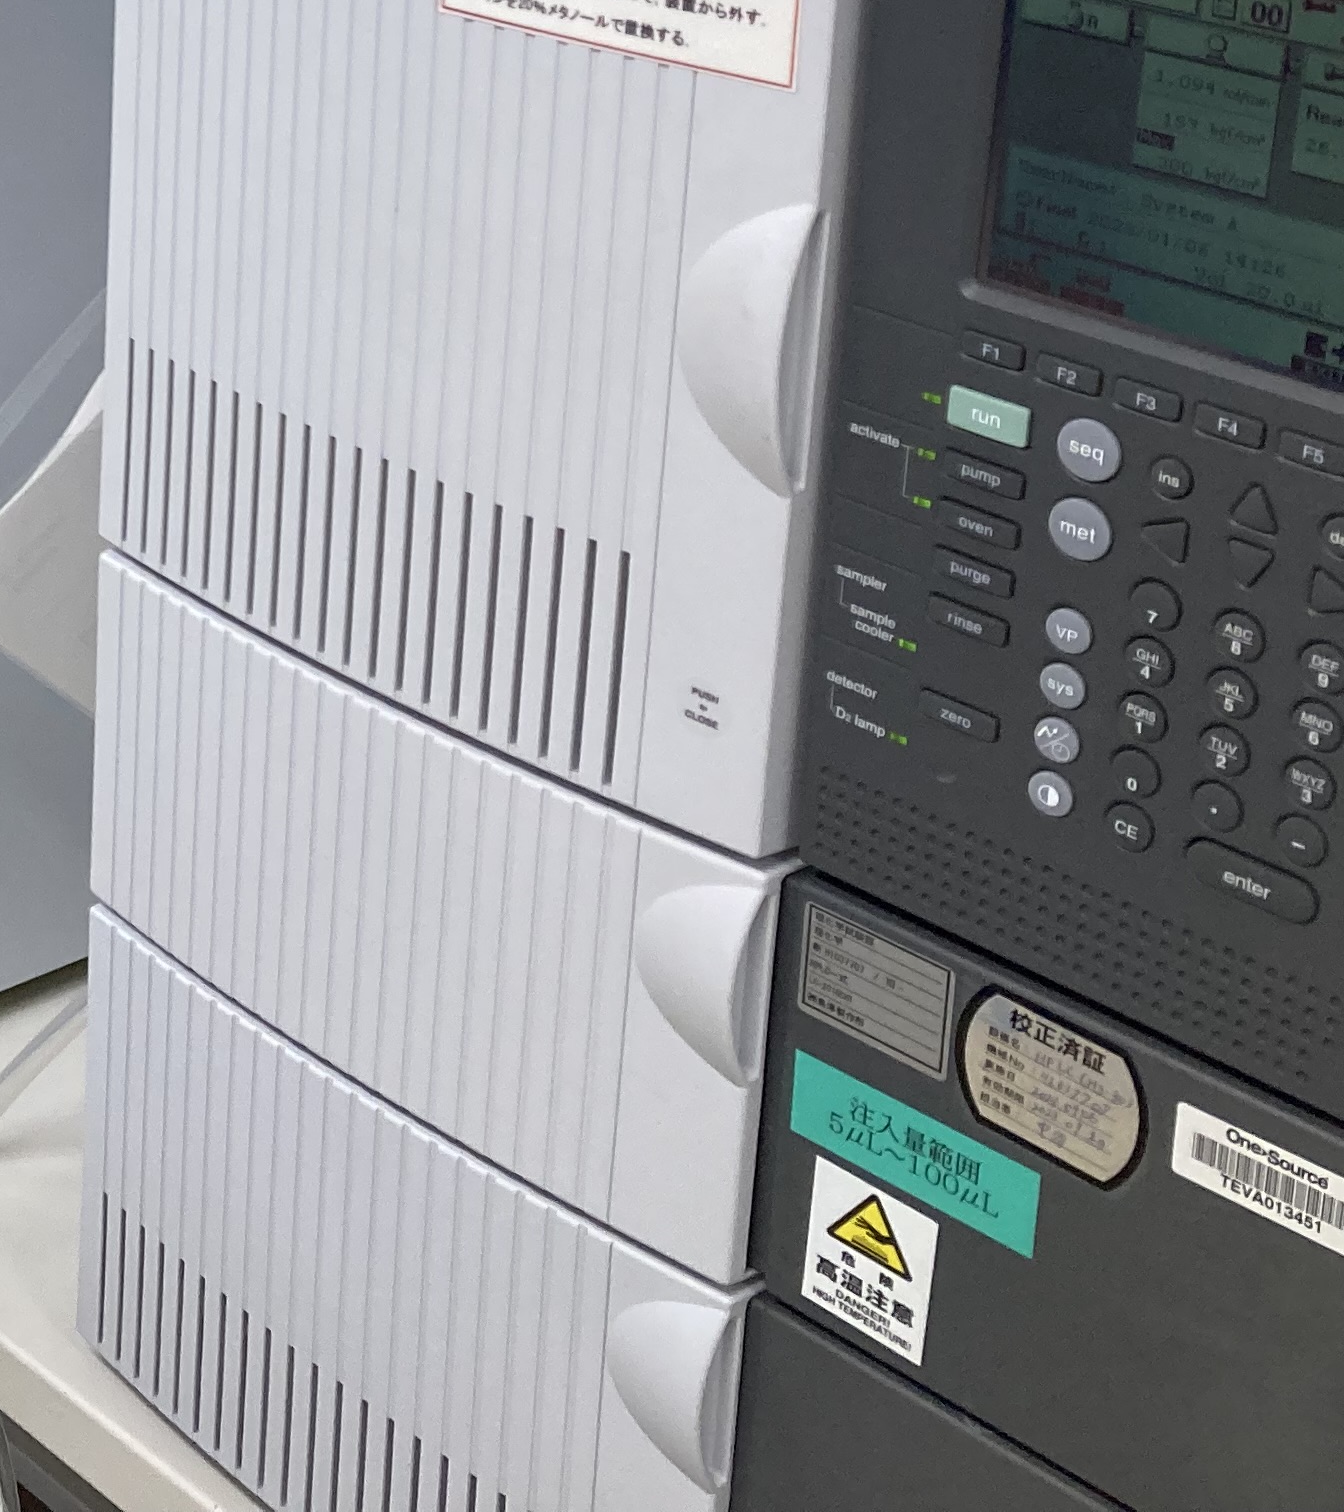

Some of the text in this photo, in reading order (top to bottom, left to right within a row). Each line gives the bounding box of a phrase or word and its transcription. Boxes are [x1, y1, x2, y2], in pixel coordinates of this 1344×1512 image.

[1250, 0, 1285, 28] 00
[982, 343, 1000, 361] F1
[1057, 366, 1077, 386] F2
[1136, 392, 1157, 411] F3
[971, 407, 1001, 429] run
[1217, 417, 1238, 437] F4
[849, 421, 901, 448] activate
[1068, 437, 1105, 467] seq
[1302, 443, 1325, 465] F5
[961, 463, 1001, 489] pump
[1158, 470, 1180, 489] ins
[958, 516, 994, 538] oven
[1059, 517, 1098, 545] met
[835, 564, 888, 592] sampler
[950, 560, 991, 586] purge
[849, 603, 896, 630] sample
[947, 612, 983, 635] rinse
[1147, 609, 1159, 624] 7
[854, 620, 895, 643] cooler
[1055, 623, 1079, 646] VP
[1224, 622, 1254, 642] ABC
[1136, 648, 1160, 666] GHI
[1140, 665, 1151, 680] 4
[826, 671, 879, 701] detector
[1047, 676, 1075, 701] sys
[854, 714, 886, 739] lamp
[940, 708, 972, 729] zero
[1211, 736, 1238, 756] TUV
[1215, 754, 1227, 770] 2
[1114, 819, 1139, 841] CE
[1222, 870, 1272, 901] enter
[1010, 1008, 1107, 1075] 校正済証
[850, 1096, 982, 1186] 注入量範囲
[1220, 1173, 1322, 1234] TEVA013451
[812, 1285, 835, 1306] HIGH
[816, 1254, 914, 1328] 高温注意
